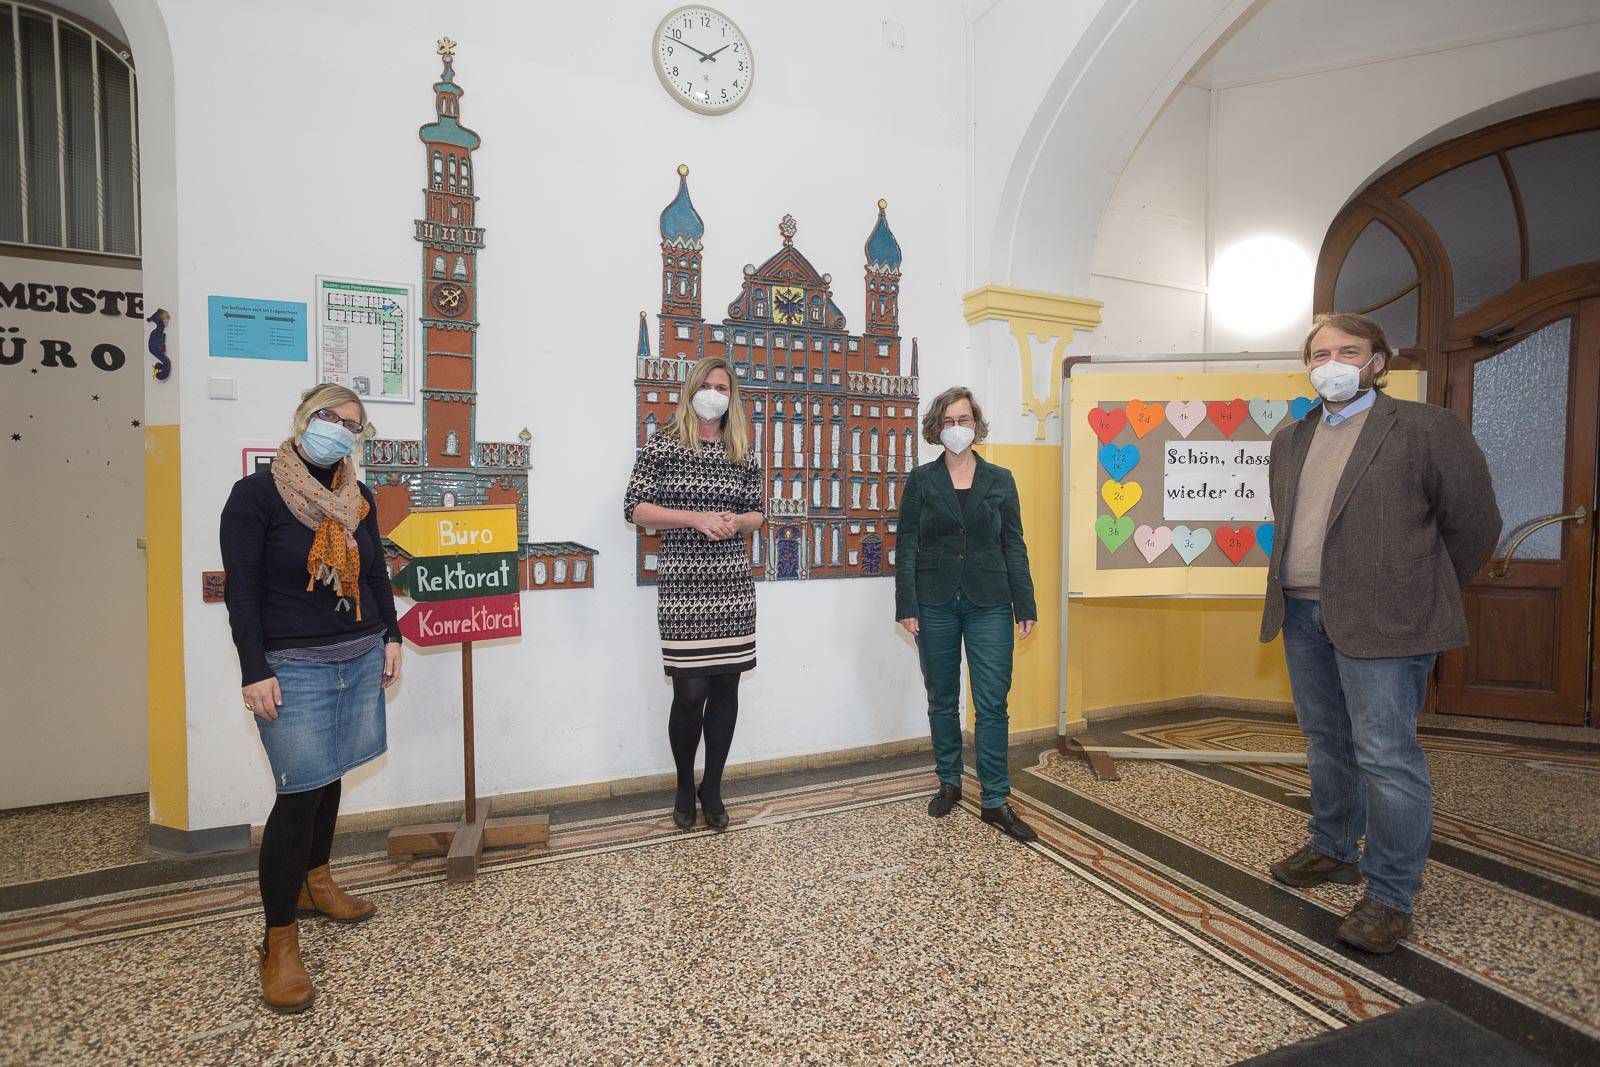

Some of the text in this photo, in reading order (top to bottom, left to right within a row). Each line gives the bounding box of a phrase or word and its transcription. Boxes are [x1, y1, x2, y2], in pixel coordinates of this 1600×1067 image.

[683, 18, 692, 29] 11
[700, 17, 711, 28] 12
[671, 28, 682, 40] 10
[721, 27, 725, 37] 1
[667, 46, 674, 57] 9
[733, 42, 739, 53] 2
[672, 66, 679, 77] 8
[737, 60, 744, 72] 3
[686, 81, 693, 92] 7
[732, 79, 738, 88] 4
[704, 90, 710, 100] 6
[720, 88, 727, 99] 5
[0, 282, 144, 319] MEISTE
[1138, 413, 1151, 423] 2d
[1179, 413, 1189, 421] 1b
[1220, 411, 1232, 420] 4d
[1262, 410, 1273, 419] 1d
[1167, 448, 1271, 466] Schön, dass
[1113, 492, 1125, 501] 2c
[1167, 482, 1255, 500] wieder da
[439, 519, 494, 546] Büro
[1108, 528, 1120, 536] 3b
[1184, 539, 1195, 549] 3c
[416, 559, 510, 593] Rektorat
[418, 601, 520, 638] Konrektorat
